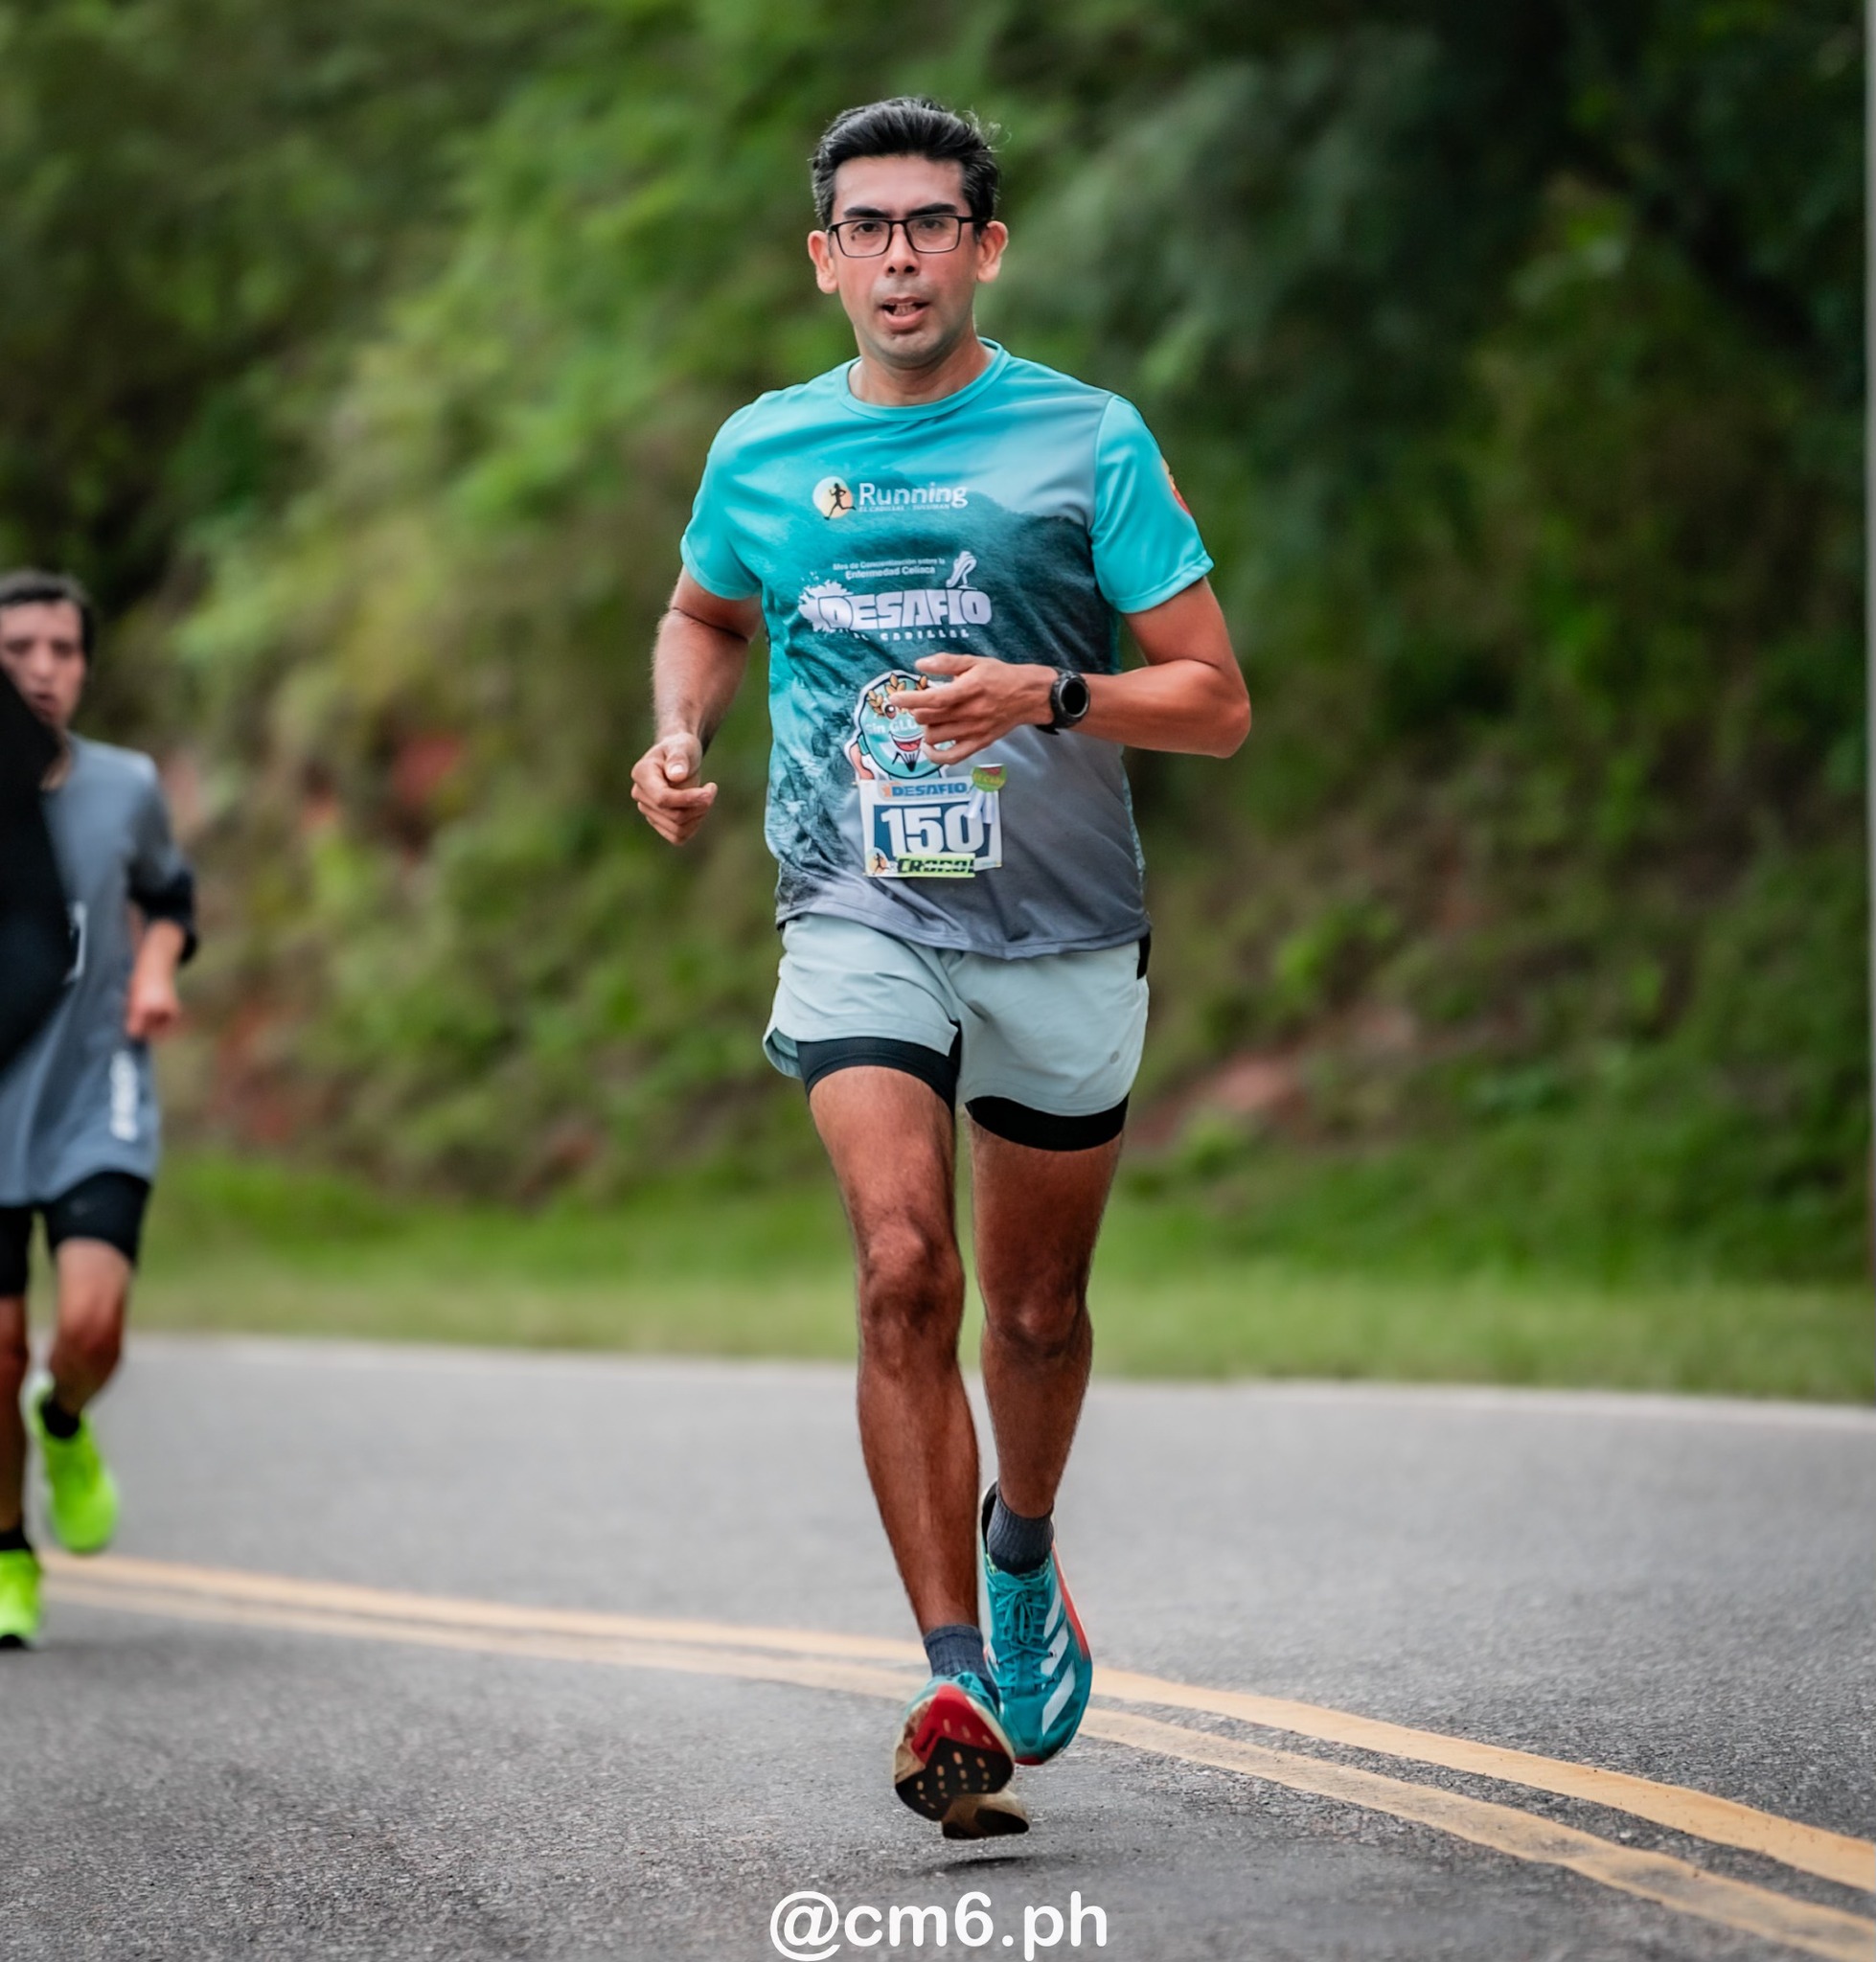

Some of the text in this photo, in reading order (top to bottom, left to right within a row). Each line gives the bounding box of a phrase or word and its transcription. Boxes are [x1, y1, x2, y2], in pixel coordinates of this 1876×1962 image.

[858, 482, 969, 509] Running
[850, 561, 859, 570] de
[845, 567, 901, 581] Enfermedad
[889, 719, 920, 734] GLU
[892, 782, 968, 797] DESAFIO
[881, 805, 985, 857] 150
